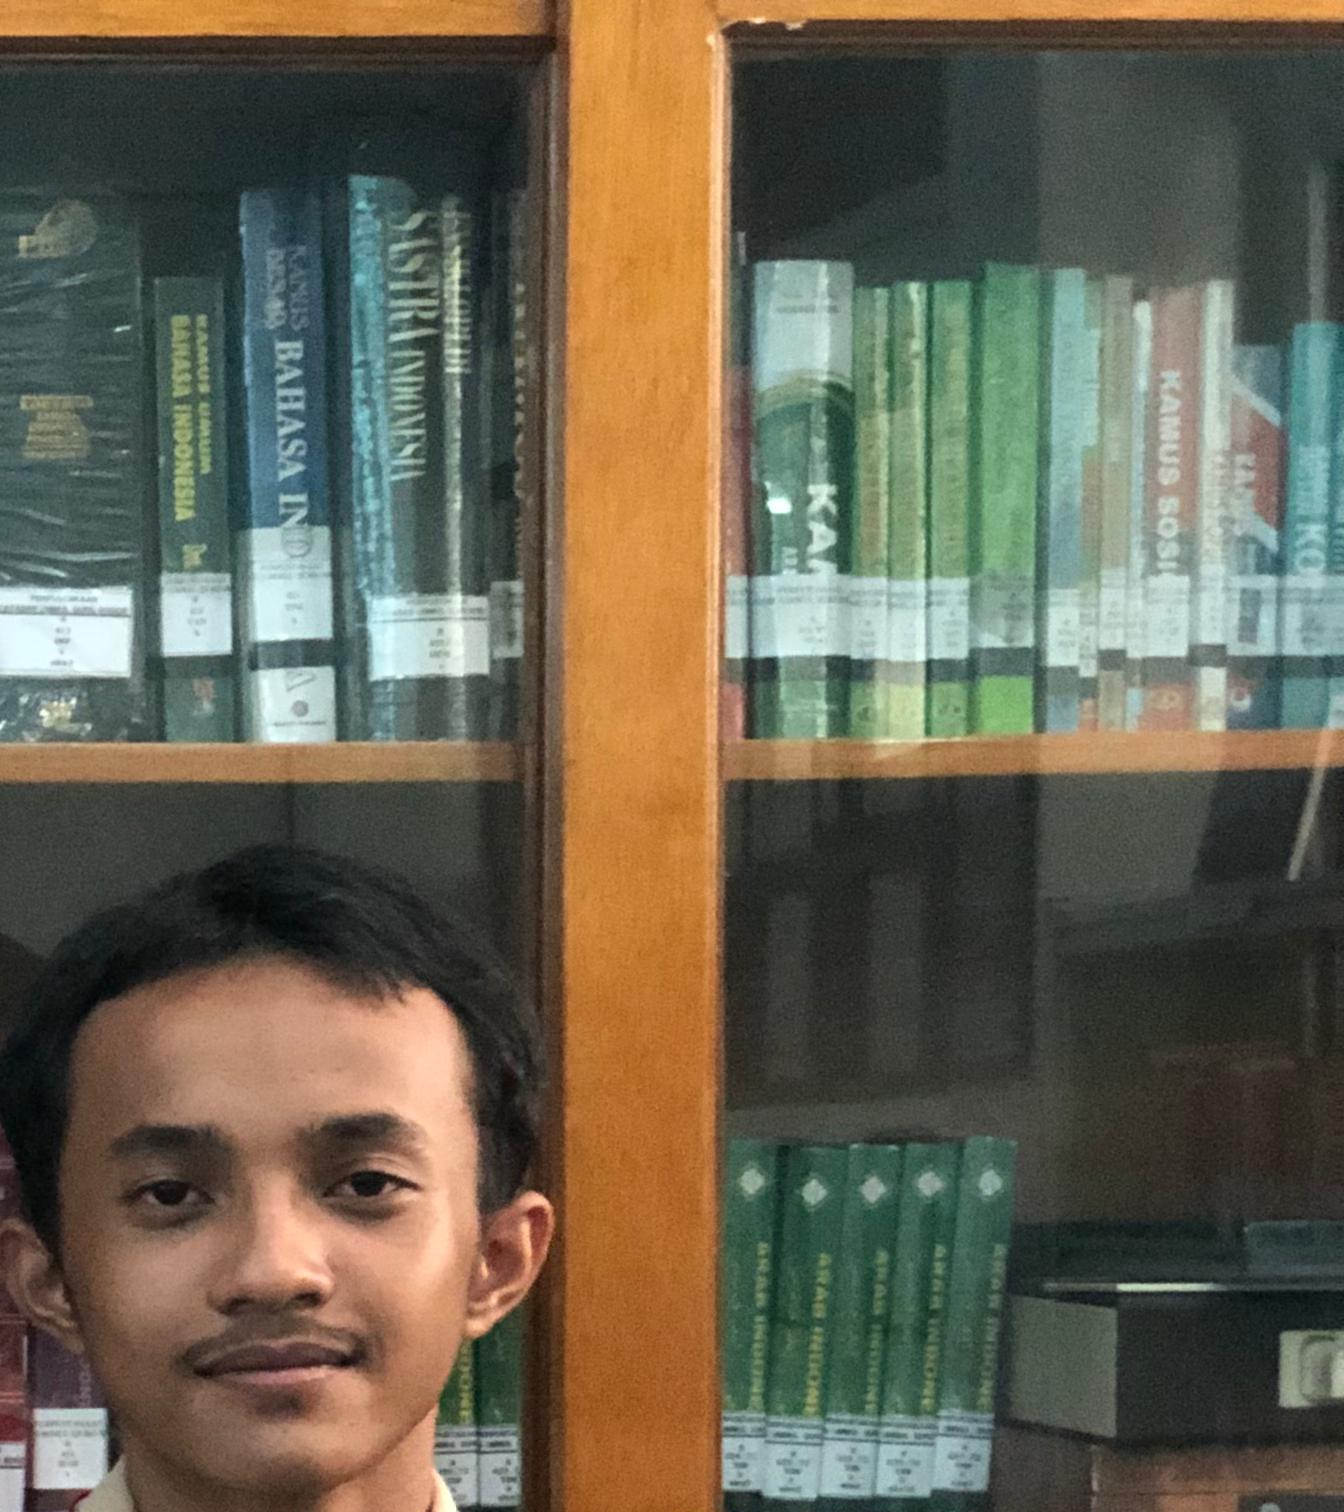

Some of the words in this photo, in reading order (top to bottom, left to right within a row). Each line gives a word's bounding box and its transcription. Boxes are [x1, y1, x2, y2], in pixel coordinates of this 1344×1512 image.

[388, 211, 440, 343] SASTRA
[171, 314, 193, 397] BAHASA
[275, 340, 307, 481] BAHASA
[389, 351, 426, 481] INDONESIA
[173, 405, 196, 521] INDONESIA
[1158, 370, 1181, 485] KAMUS
